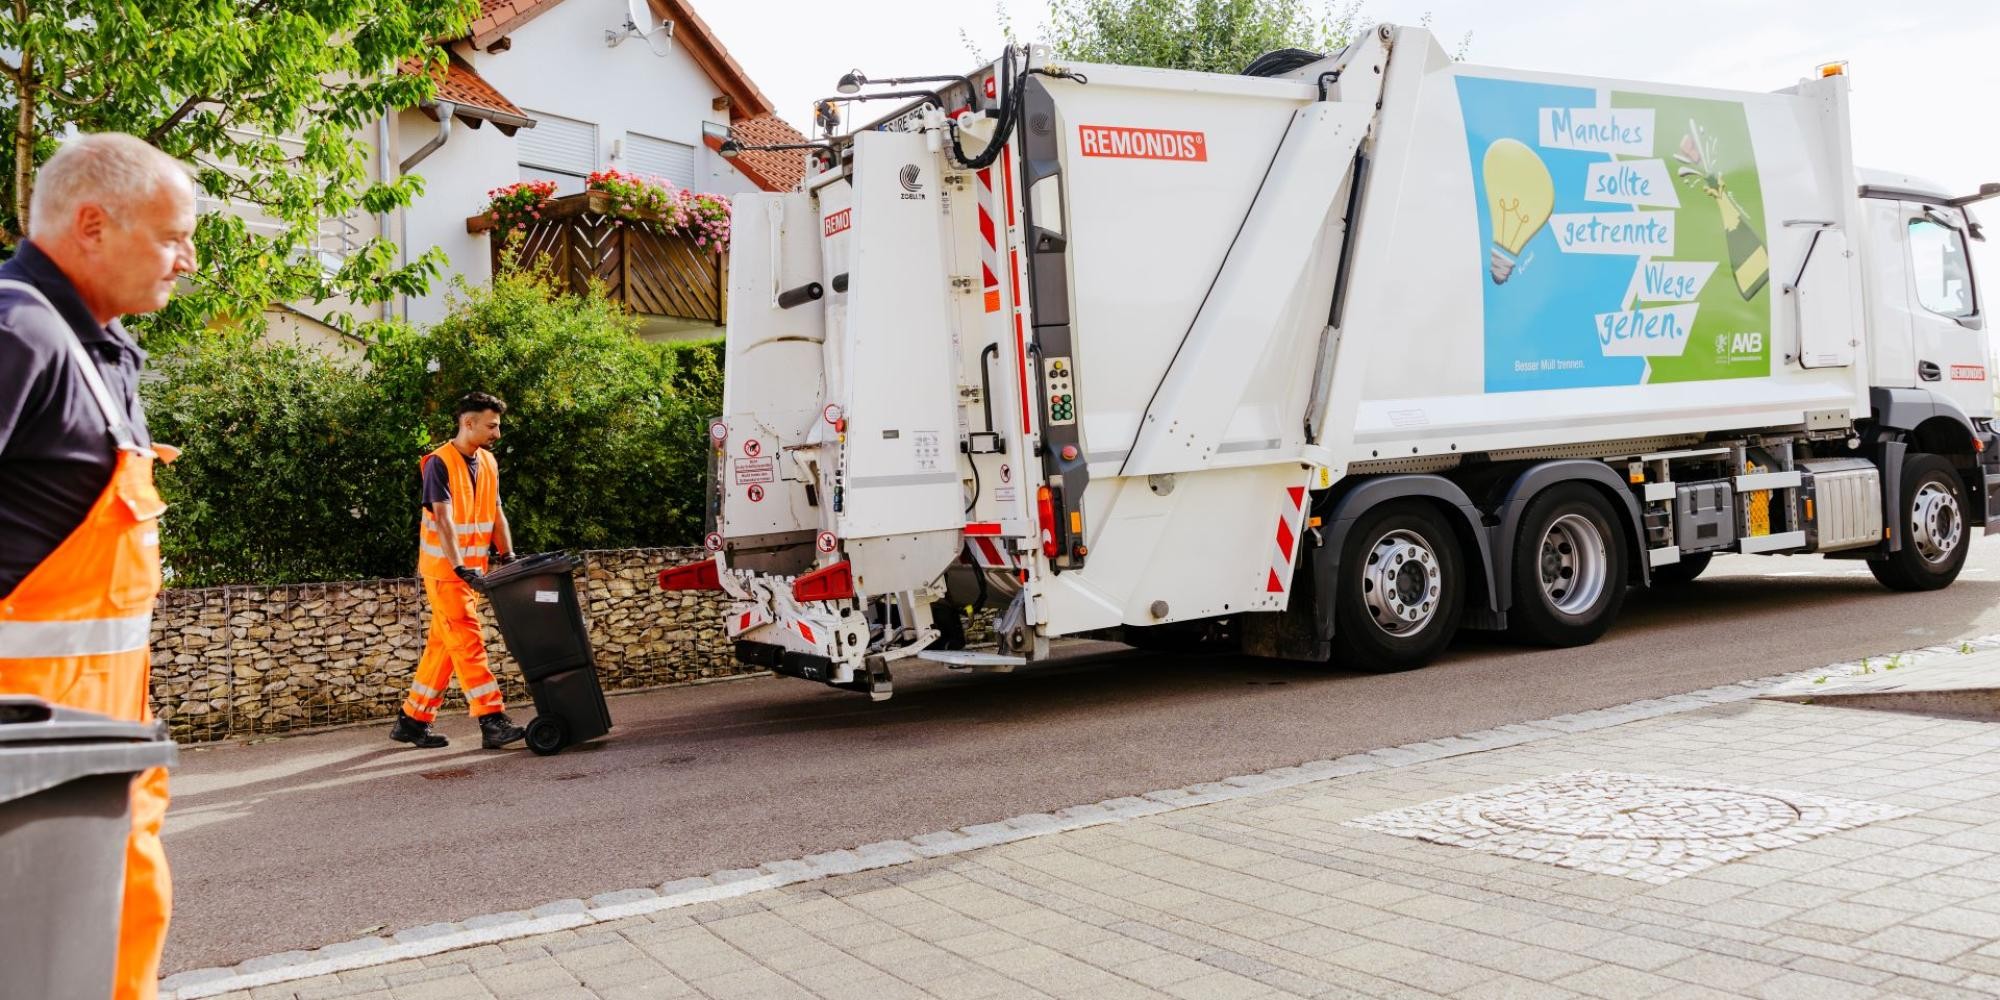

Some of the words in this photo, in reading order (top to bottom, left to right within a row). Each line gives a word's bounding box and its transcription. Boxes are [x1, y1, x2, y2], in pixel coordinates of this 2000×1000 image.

[1551, 109, 1643, 144] Manches
[1596, 166, 1651, 196] sollte
[1564, 216, 1668, 245] getrennte
[1645, 263, 1695, 298] Wege
[1599, 299, 1683, 345] gehen.
[1731, 333, 1762, 353] AWB
